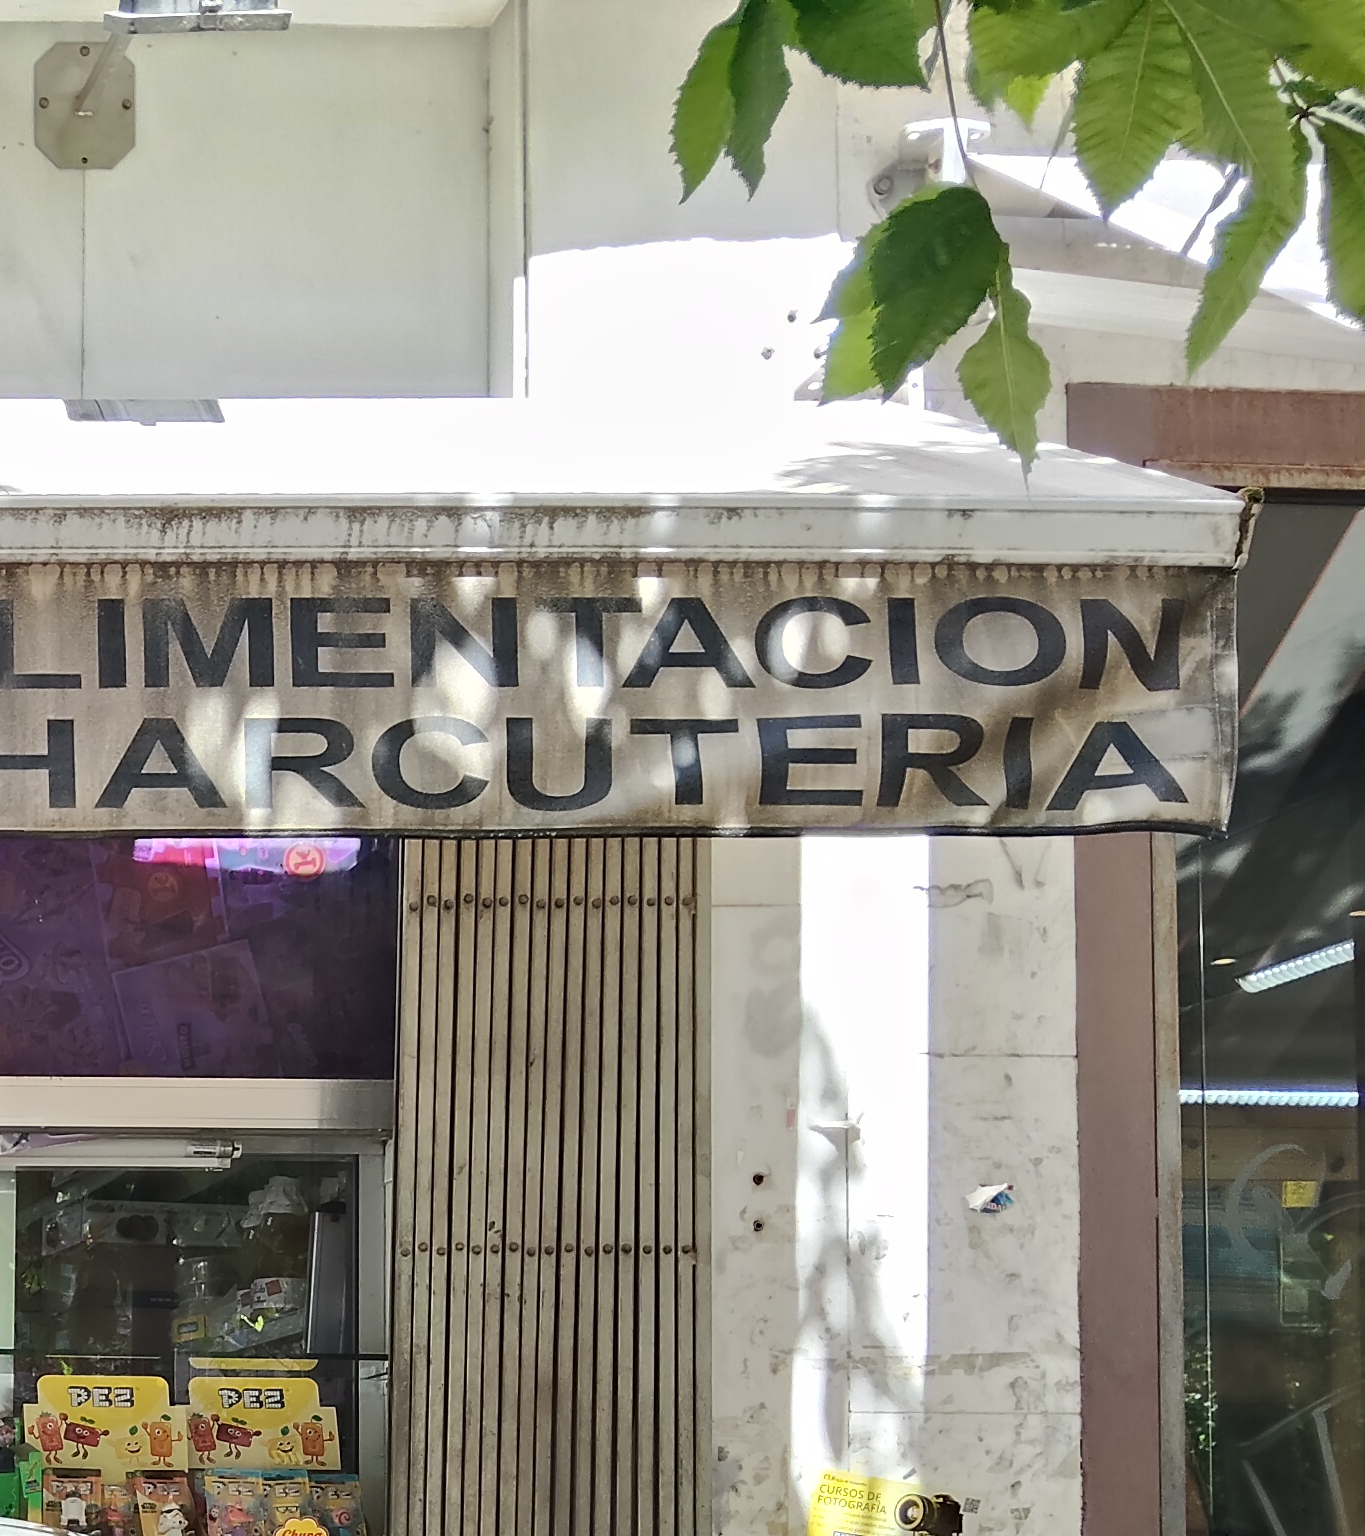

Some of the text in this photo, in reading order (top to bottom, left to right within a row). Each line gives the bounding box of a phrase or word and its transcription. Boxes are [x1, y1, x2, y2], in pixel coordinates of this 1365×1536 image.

[68, 1386, 135, 1408] PEZ
[218, 1388, 286, 1410] PEZ
[819, 1483, 881, 1502] CURSOS DE
[817, 1495, 887, 1514] FOTOGRAFÍA
